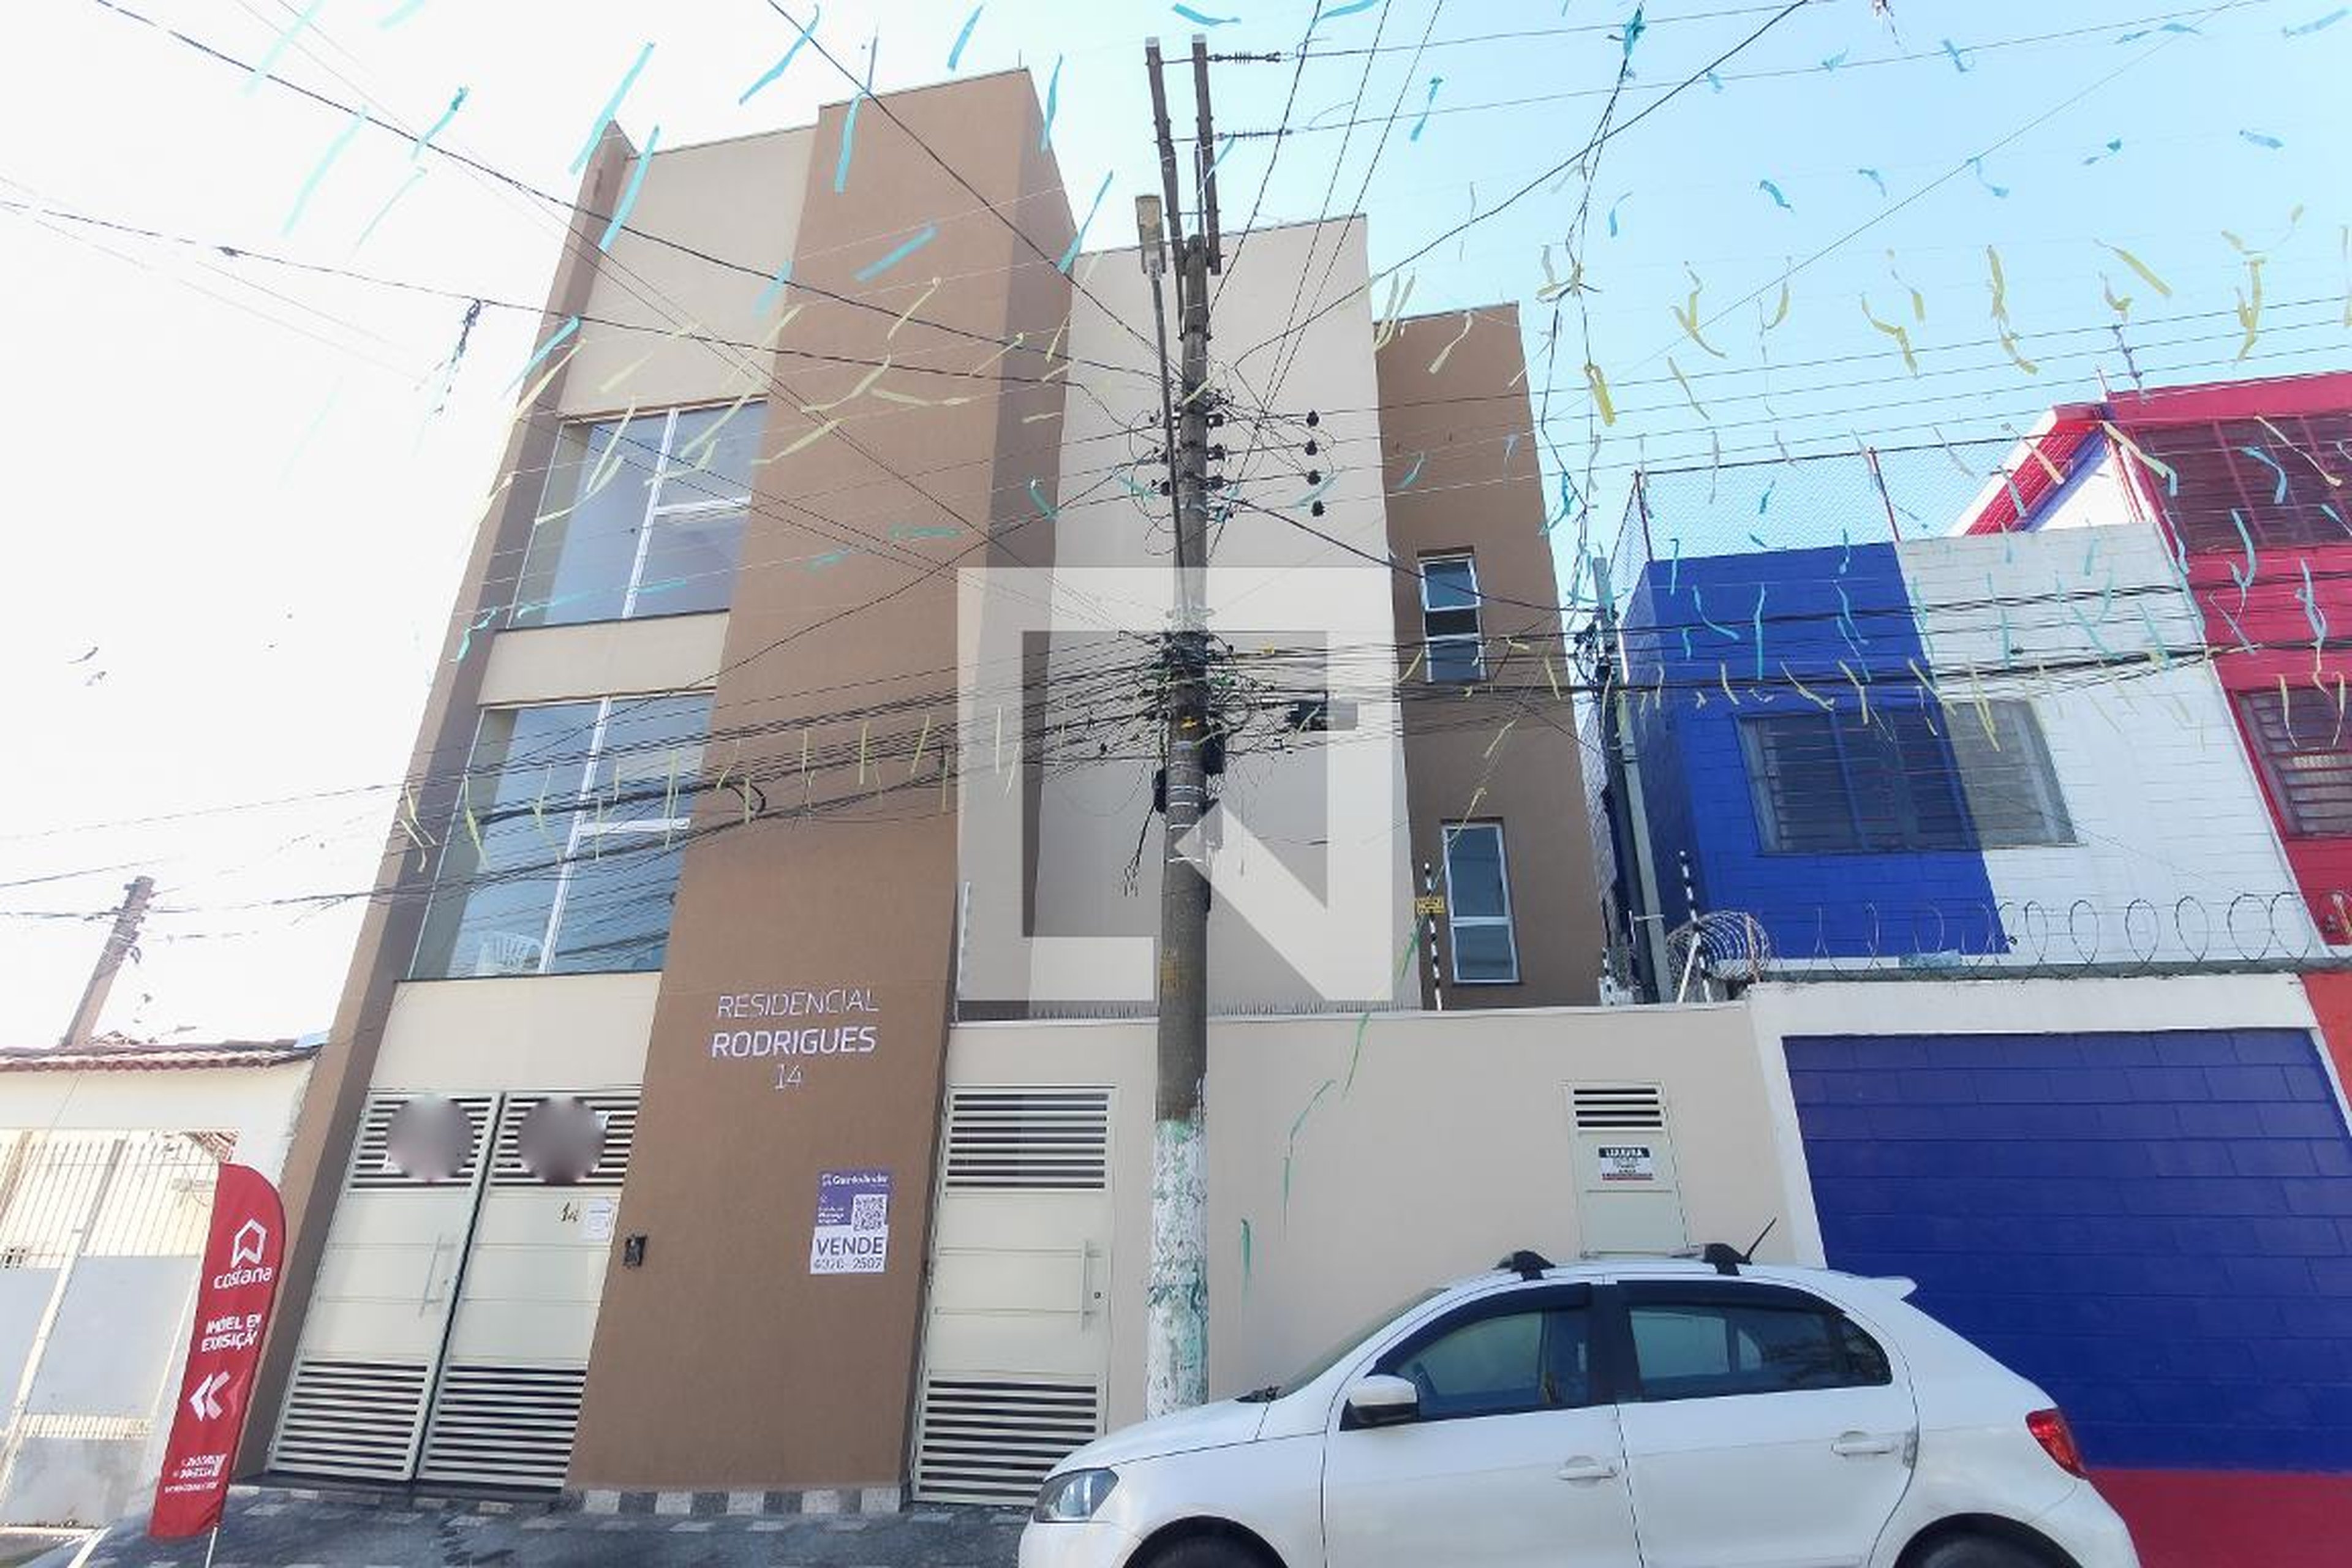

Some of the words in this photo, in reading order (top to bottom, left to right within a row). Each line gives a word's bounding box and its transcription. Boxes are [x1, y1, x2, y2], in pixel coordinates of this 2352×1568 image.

[717, 988, 880, 1018] RESIDENCIAL
[712, 1026, 877, 1058] RODRIGUES
[774, 1063, 802, 1090] 14
[816, 1237, 884, 1256] VENDE
